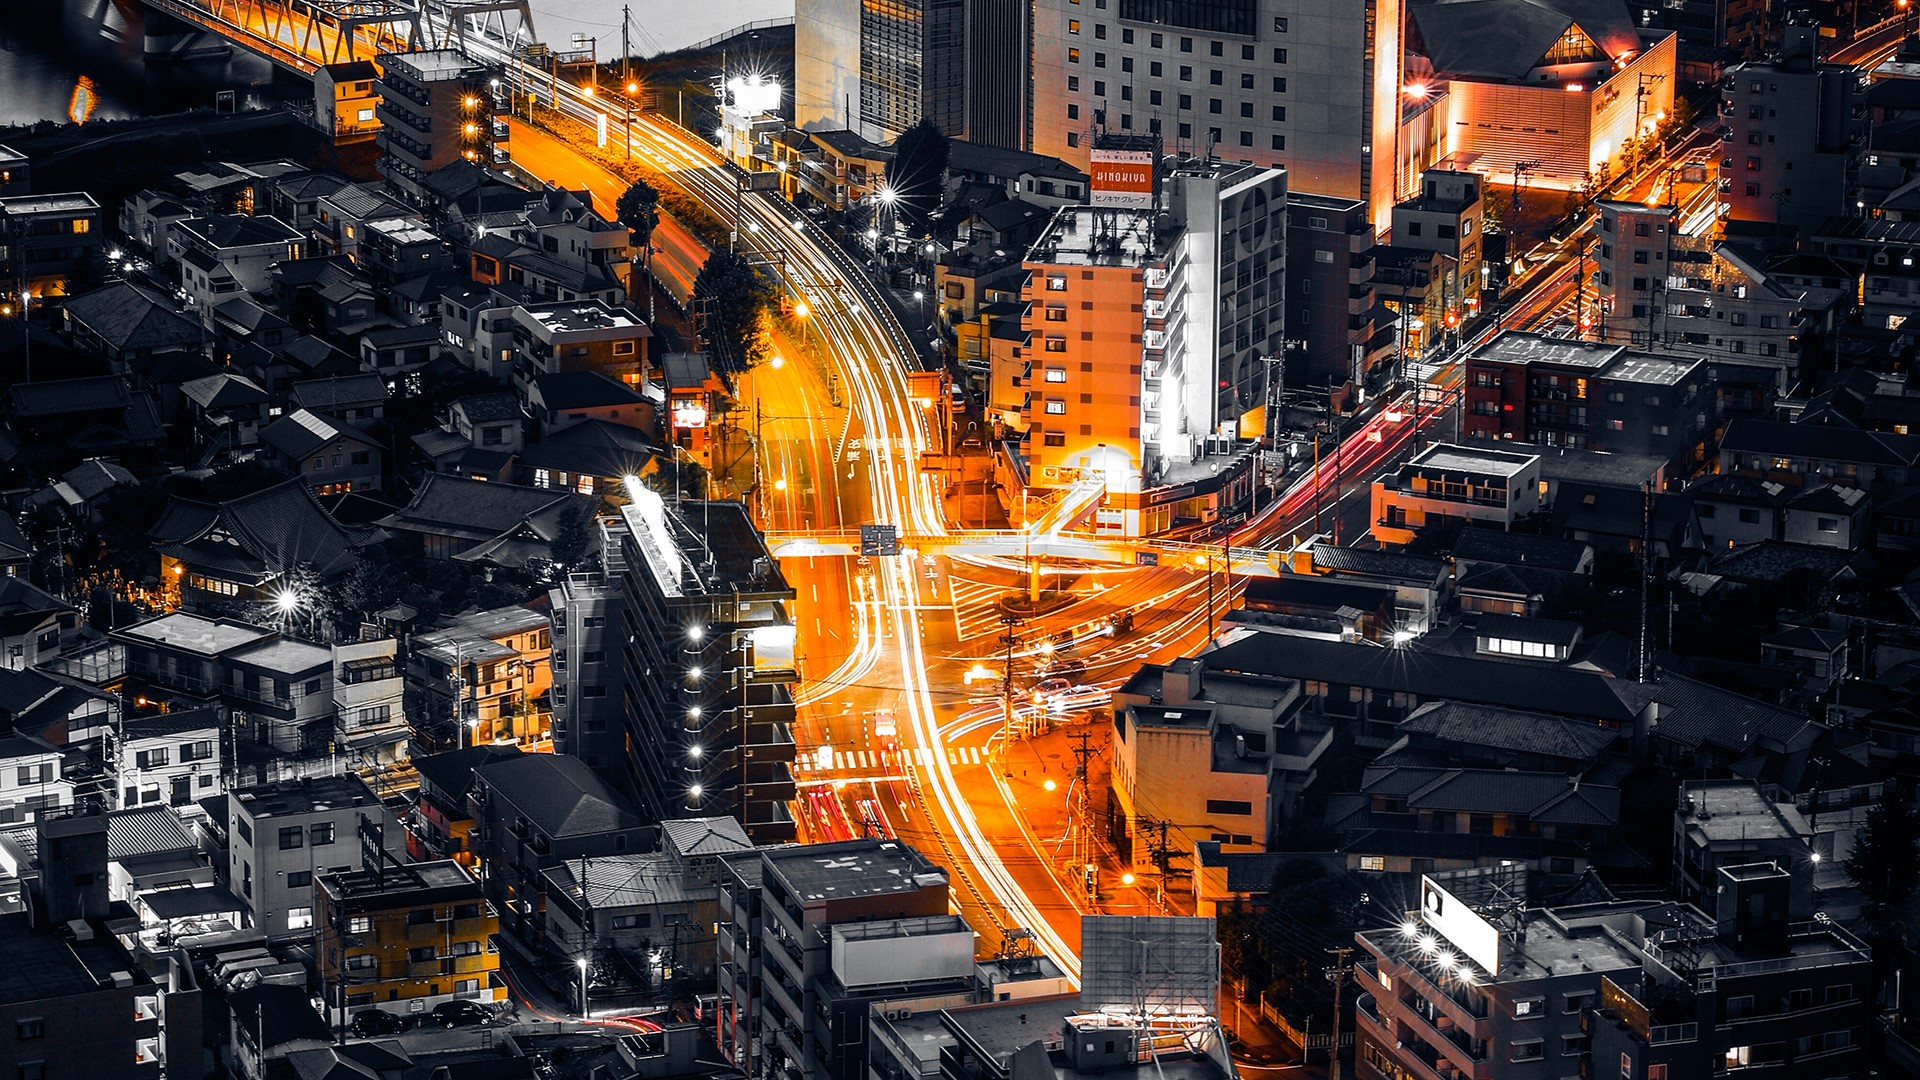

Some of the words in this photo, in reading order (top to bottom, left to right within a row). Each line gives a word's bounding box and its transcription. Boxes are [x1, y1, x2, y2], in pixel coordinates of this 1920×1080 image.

[1097, 171, 1146, 183] HINOKIYA
[1095, 195, 1146, 203] ヒノキヤグループ
